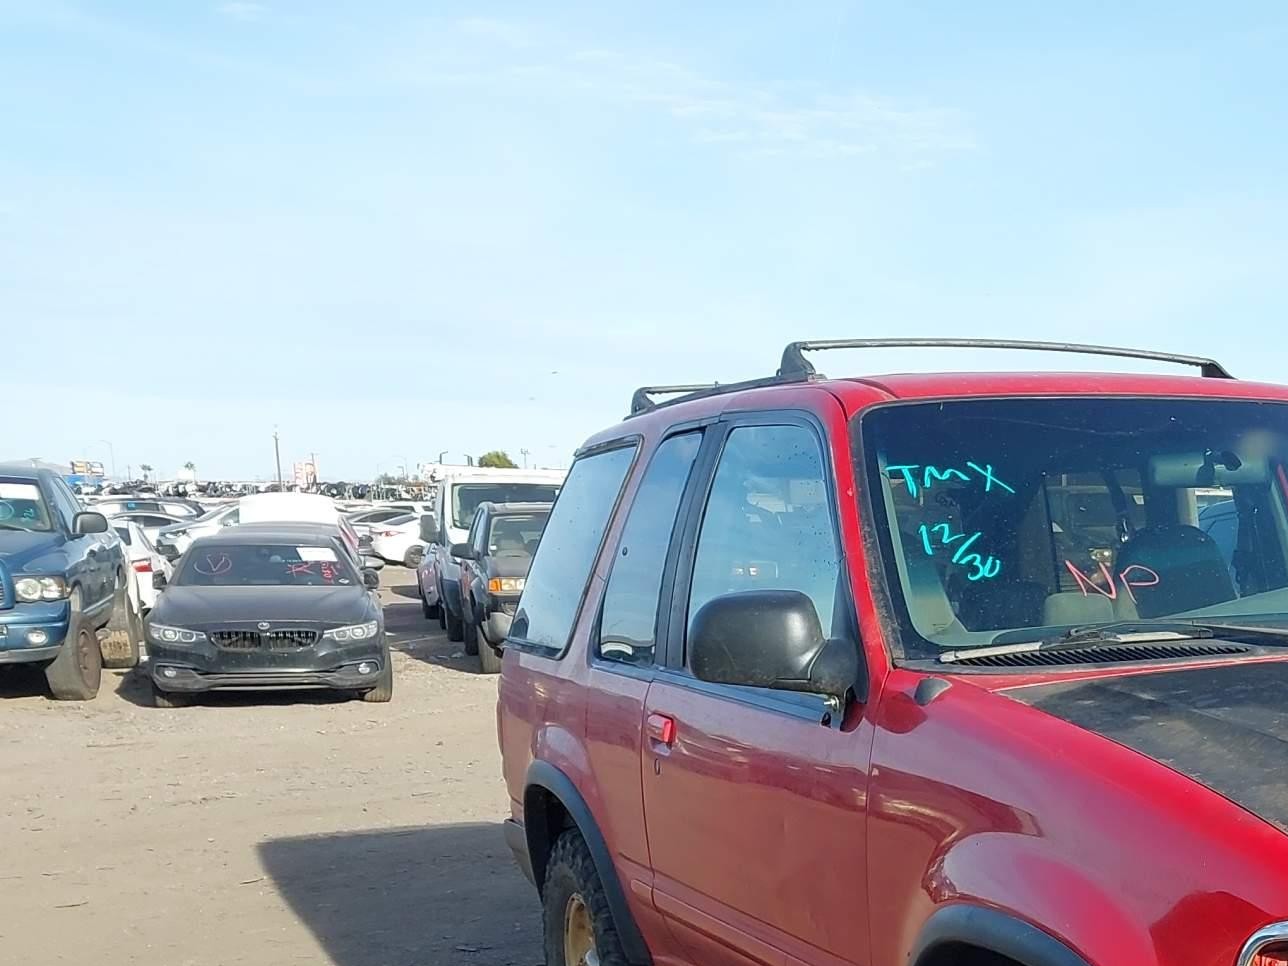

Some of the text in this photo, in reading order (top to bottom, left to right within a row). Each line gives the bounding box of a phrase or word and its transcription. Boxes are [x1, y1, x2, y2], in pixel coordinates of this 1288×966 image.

[884, 461, 1017, 498] TMX
[918, 523, 1001, 582] 12/30
[1065, 559, 1161, 605] NP
